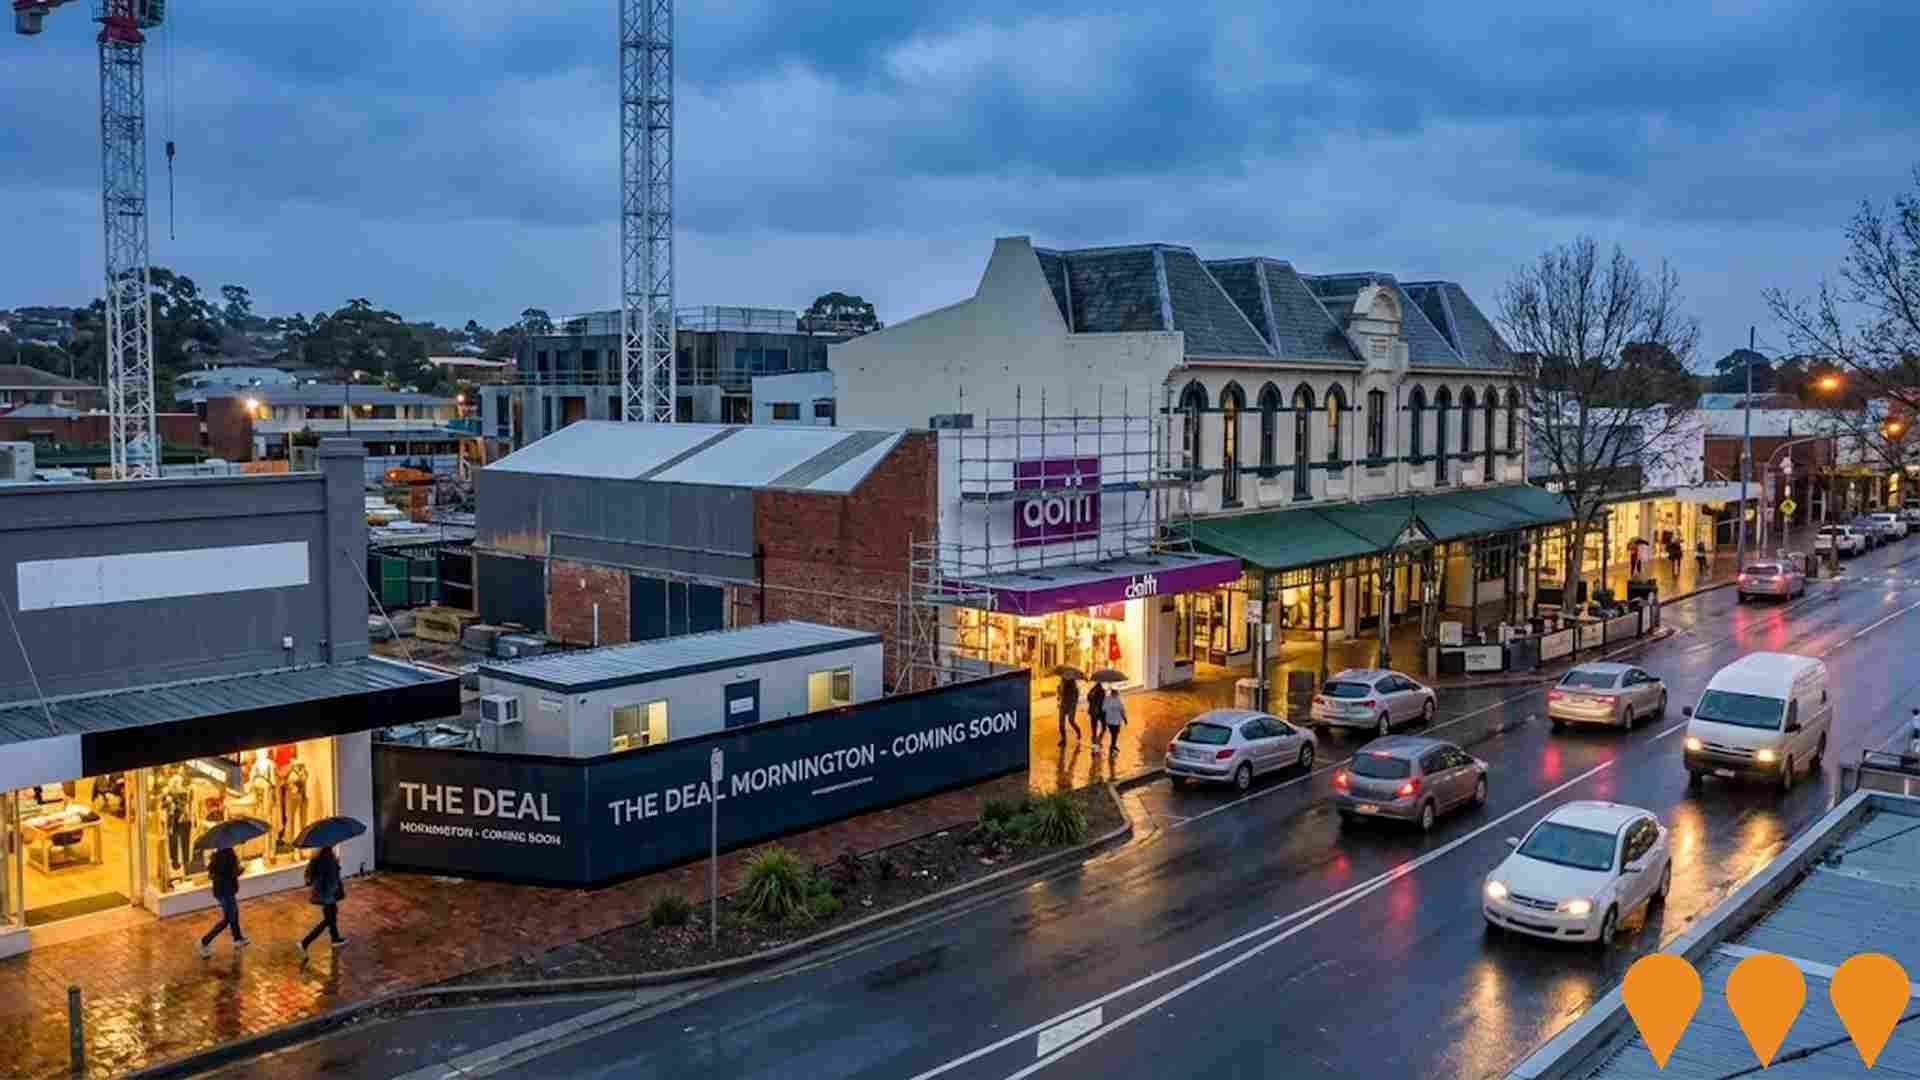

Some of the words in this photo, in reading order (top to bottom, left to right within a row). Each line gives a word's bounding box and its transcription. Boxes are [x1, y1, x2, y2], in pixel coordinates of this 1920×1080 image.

[400, 782, 464, 815] THE
[473, 787, 561, 822] DEAL
[608, 792, 659, 826] THE
[731, 744, 875, 797] MORNINGTON
[892, 723, 966, 757] COMING
[969, 710, 1017, 739] SOON
